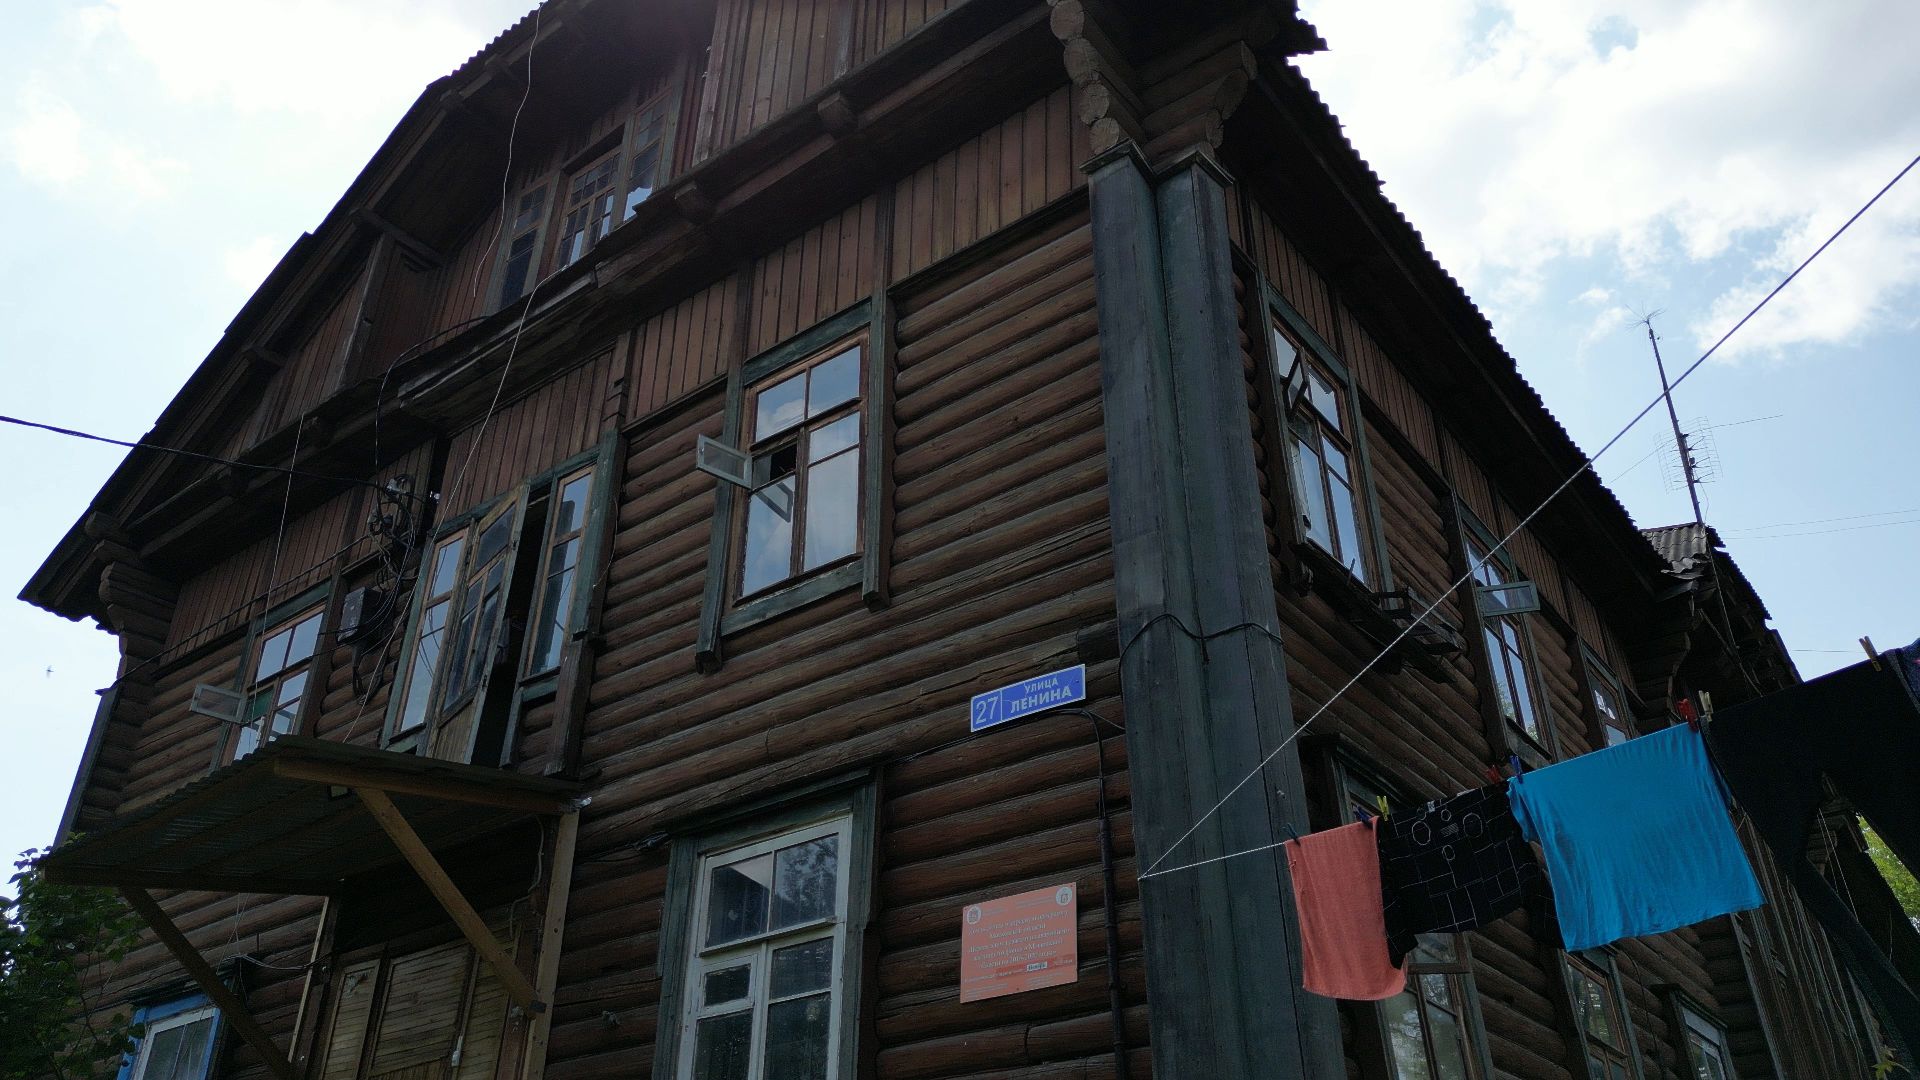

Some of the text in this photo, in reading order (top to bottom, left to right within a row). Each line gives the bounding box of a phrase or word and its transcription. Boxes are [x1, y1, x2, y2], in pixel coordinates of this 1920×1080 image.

[1010, 685, 1072, 714] ЛЕНИНА
[1024, 677, 1059, 694] УЛИЦА
[975, 696, 999, 725] 27
